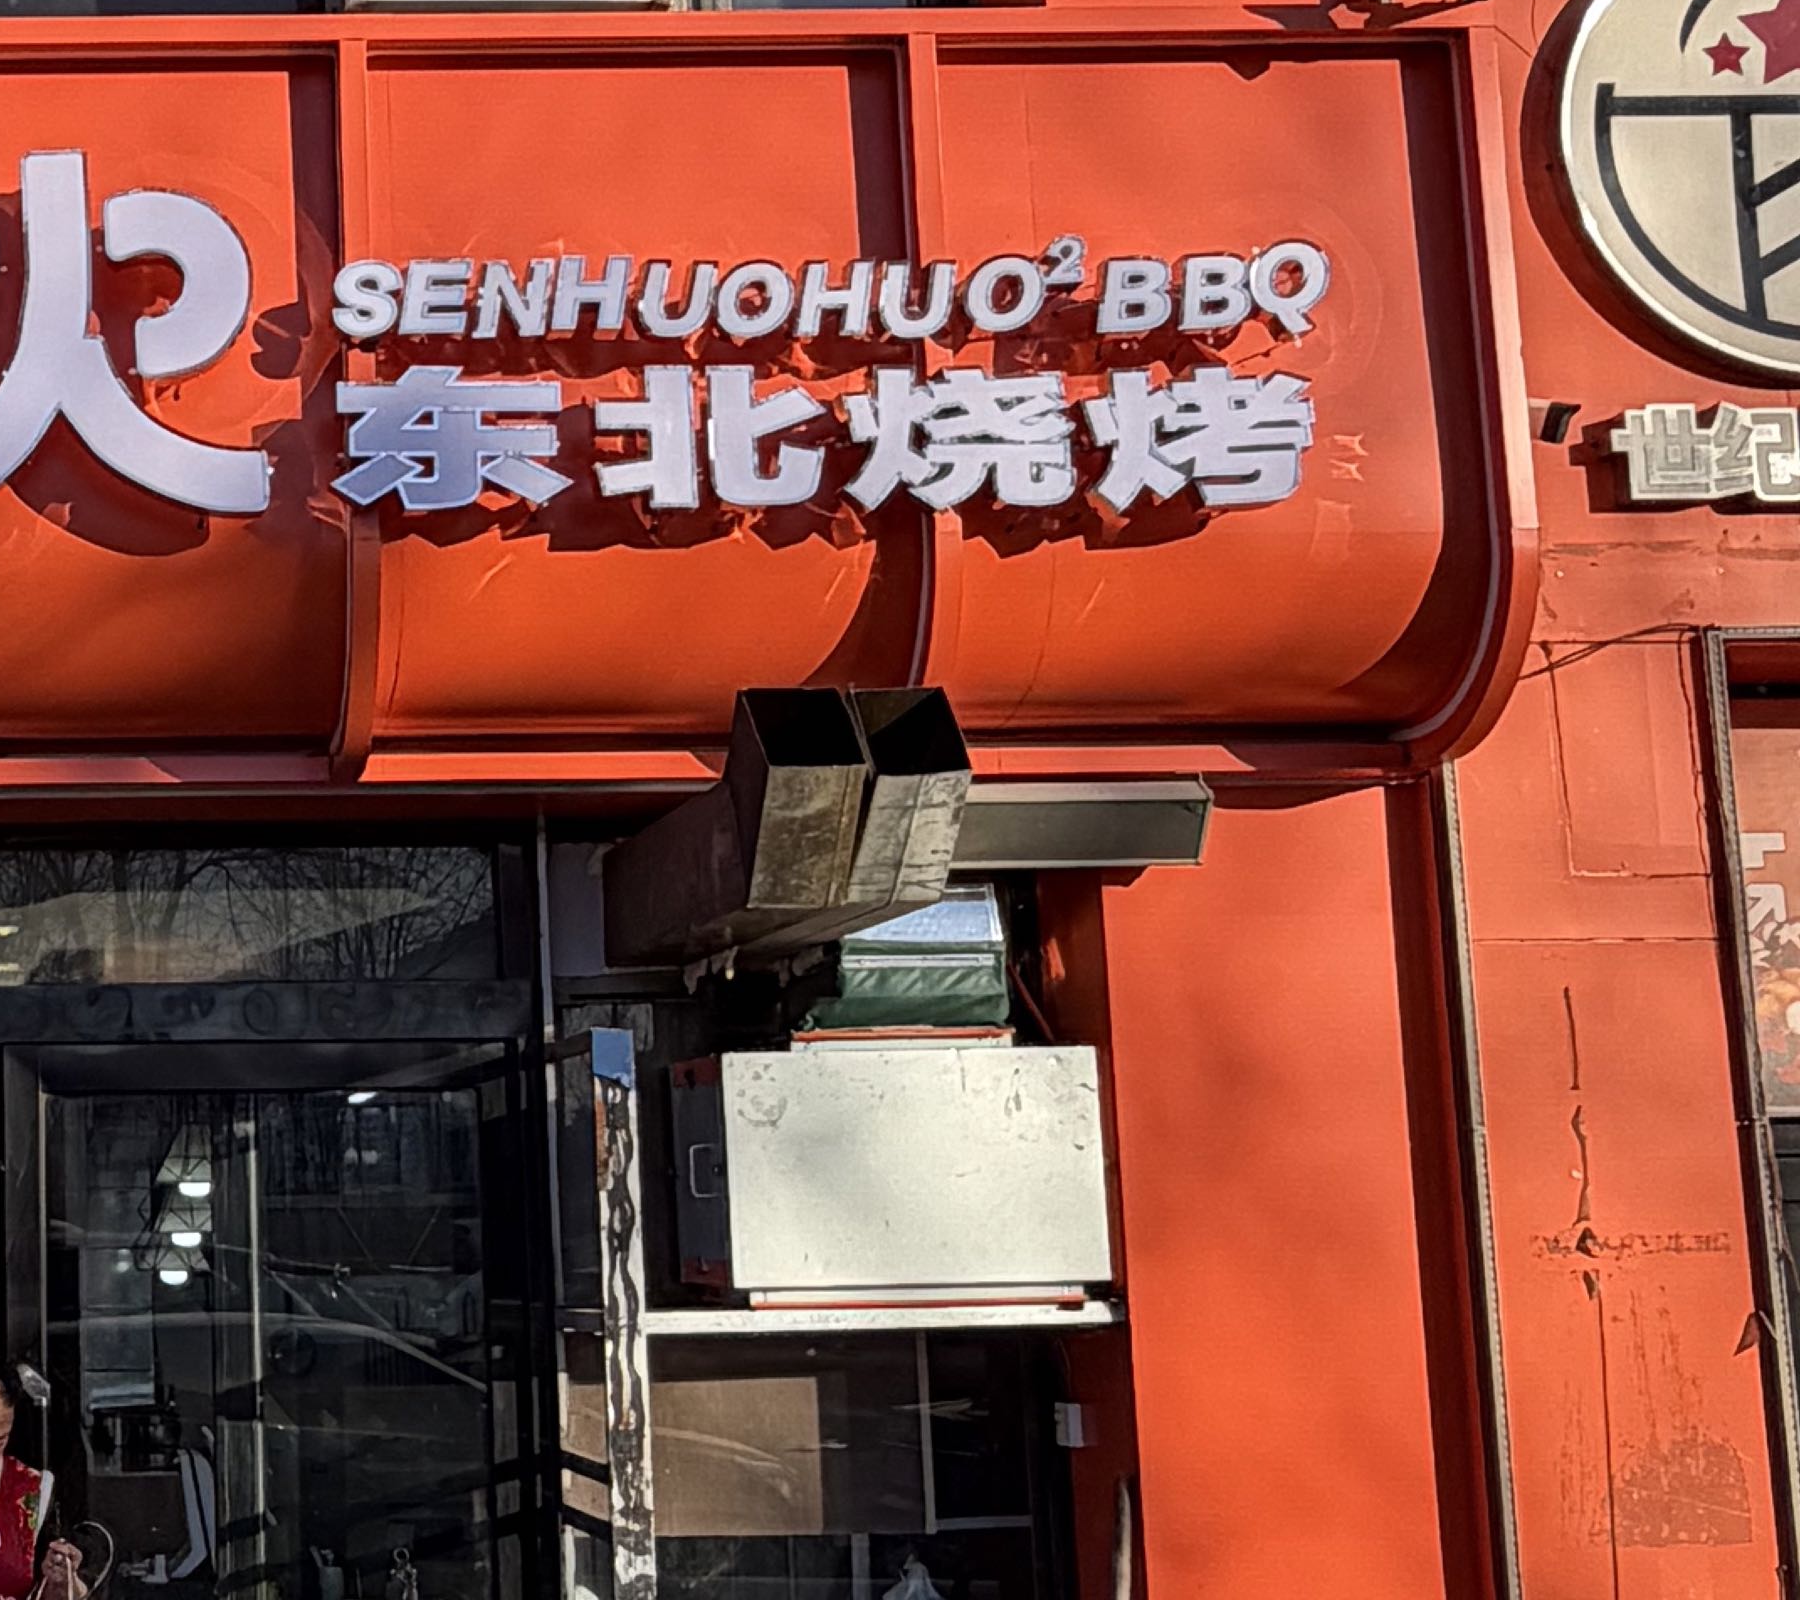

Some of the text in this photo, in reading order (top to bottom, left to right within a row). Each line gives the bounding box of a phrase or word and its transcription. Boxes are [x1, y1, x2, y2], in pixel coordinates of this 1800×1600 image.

[1096, 240, 1332, 337] BBQ
[332, 364, 1313, 514] 东北烧烤
